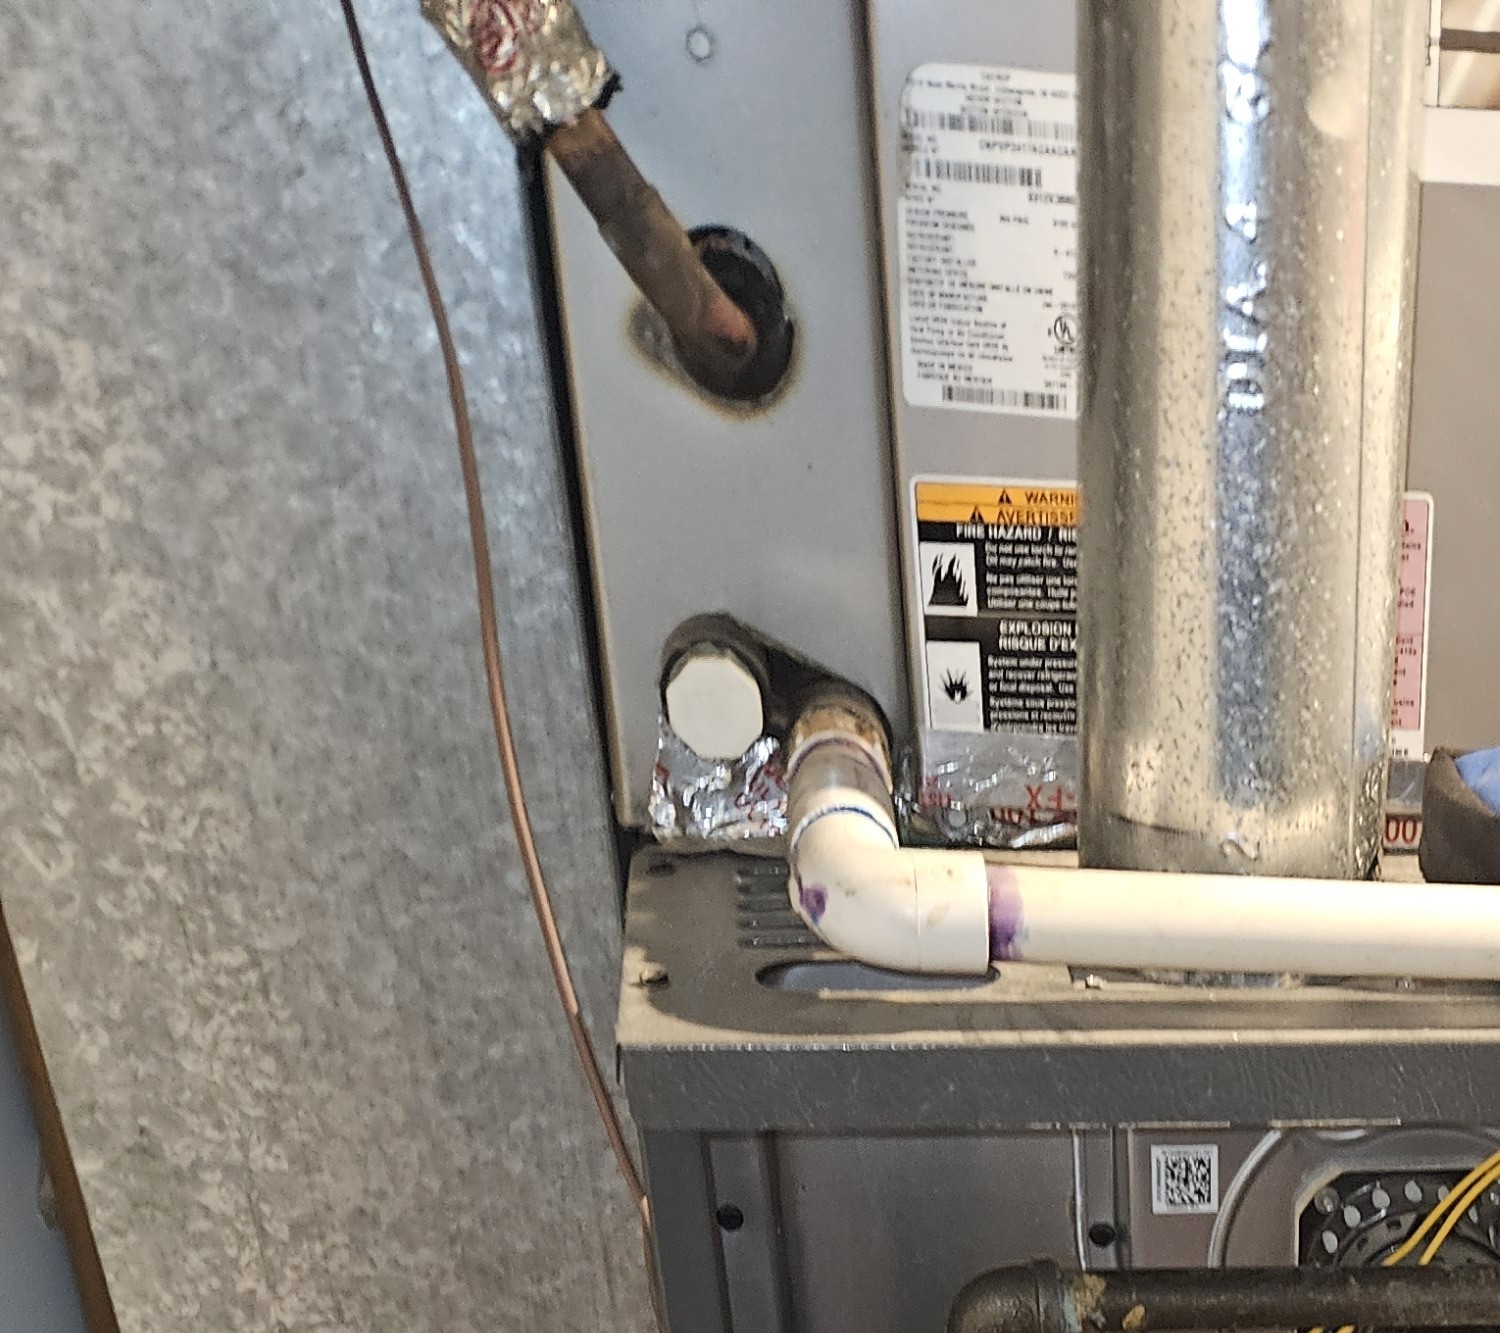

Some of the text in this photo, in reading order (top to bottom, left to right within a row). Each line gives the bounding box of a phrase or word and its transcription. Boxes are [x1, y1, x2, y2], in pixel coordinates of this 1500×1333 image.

[1024, 490, 1077, 506] WARNI
[996, 509, 1077, 525] AVERTISSE
[988, 524, 1042, 541] HAZARD
[999, 619, 1072, 636] EXPLOSION
[1049, 636, 1077, 652] D'EX
